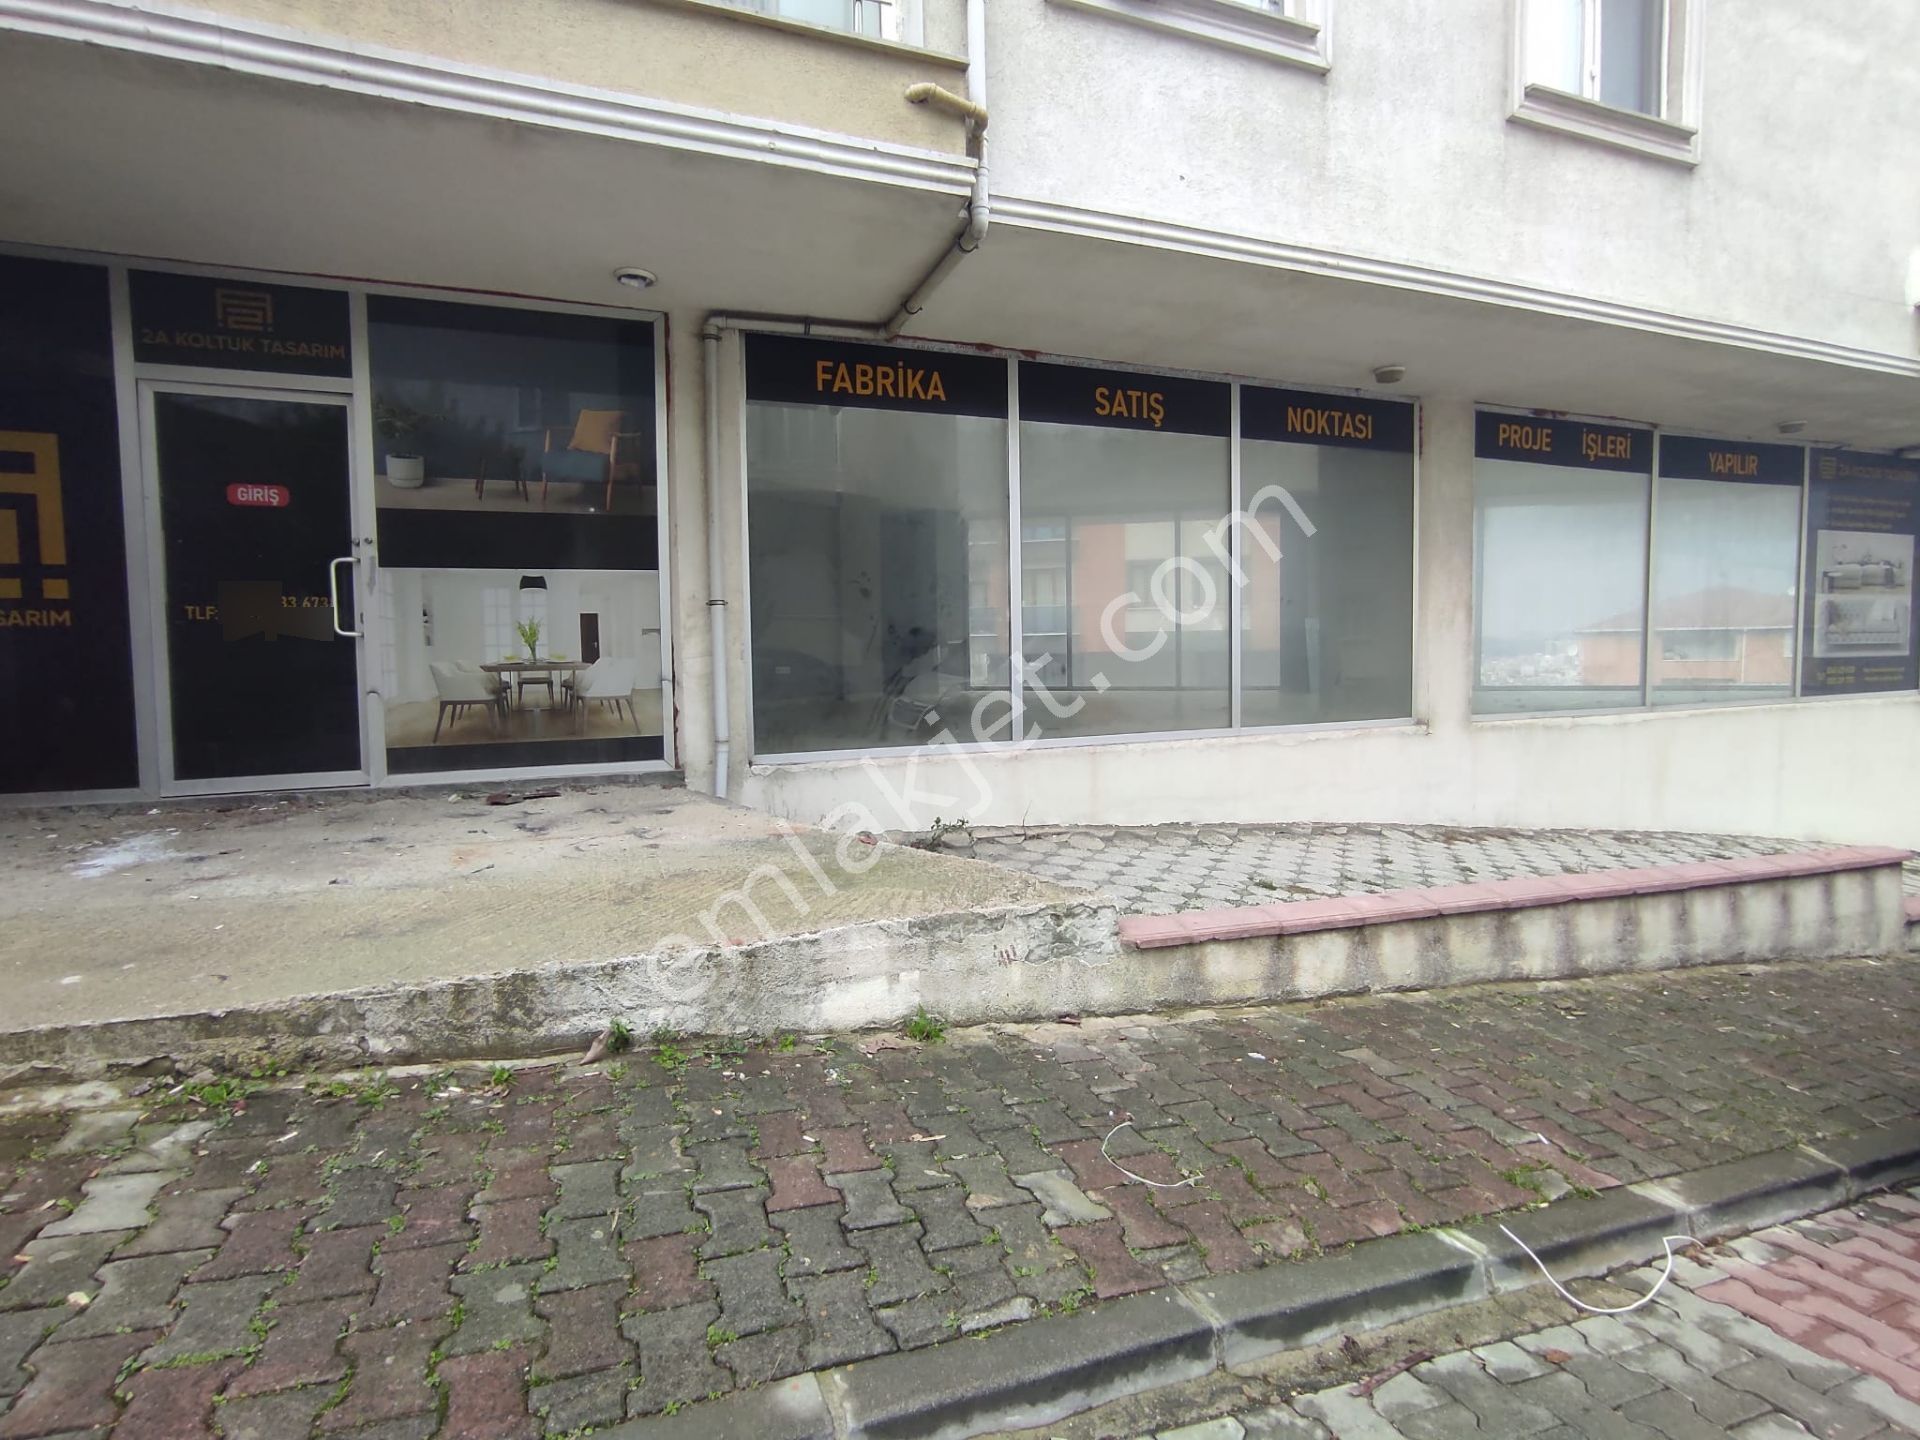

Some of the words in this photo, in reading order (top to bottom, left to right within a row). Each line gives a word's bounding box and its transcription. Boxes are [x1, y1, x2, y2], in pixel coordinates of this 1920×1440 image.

[142, 329, 169, 346] 2A
[175, 332, 256, 352] KOLTUK
[258, 338, 347, 360] TASARIM
[816, 360, 946, 401] FABRİKA
[1094, 387, 1165, 428] SATIŞ
[1286, 406, 1373, 440] NOKTASI
[1498, 423, 1552, 451] PROJE
[1581, 428, 1632, 461] İŞLERİ
[1708, 452, 1759, 476] YAPILIR
[236, 485, 280, 507] GİRİŞ
